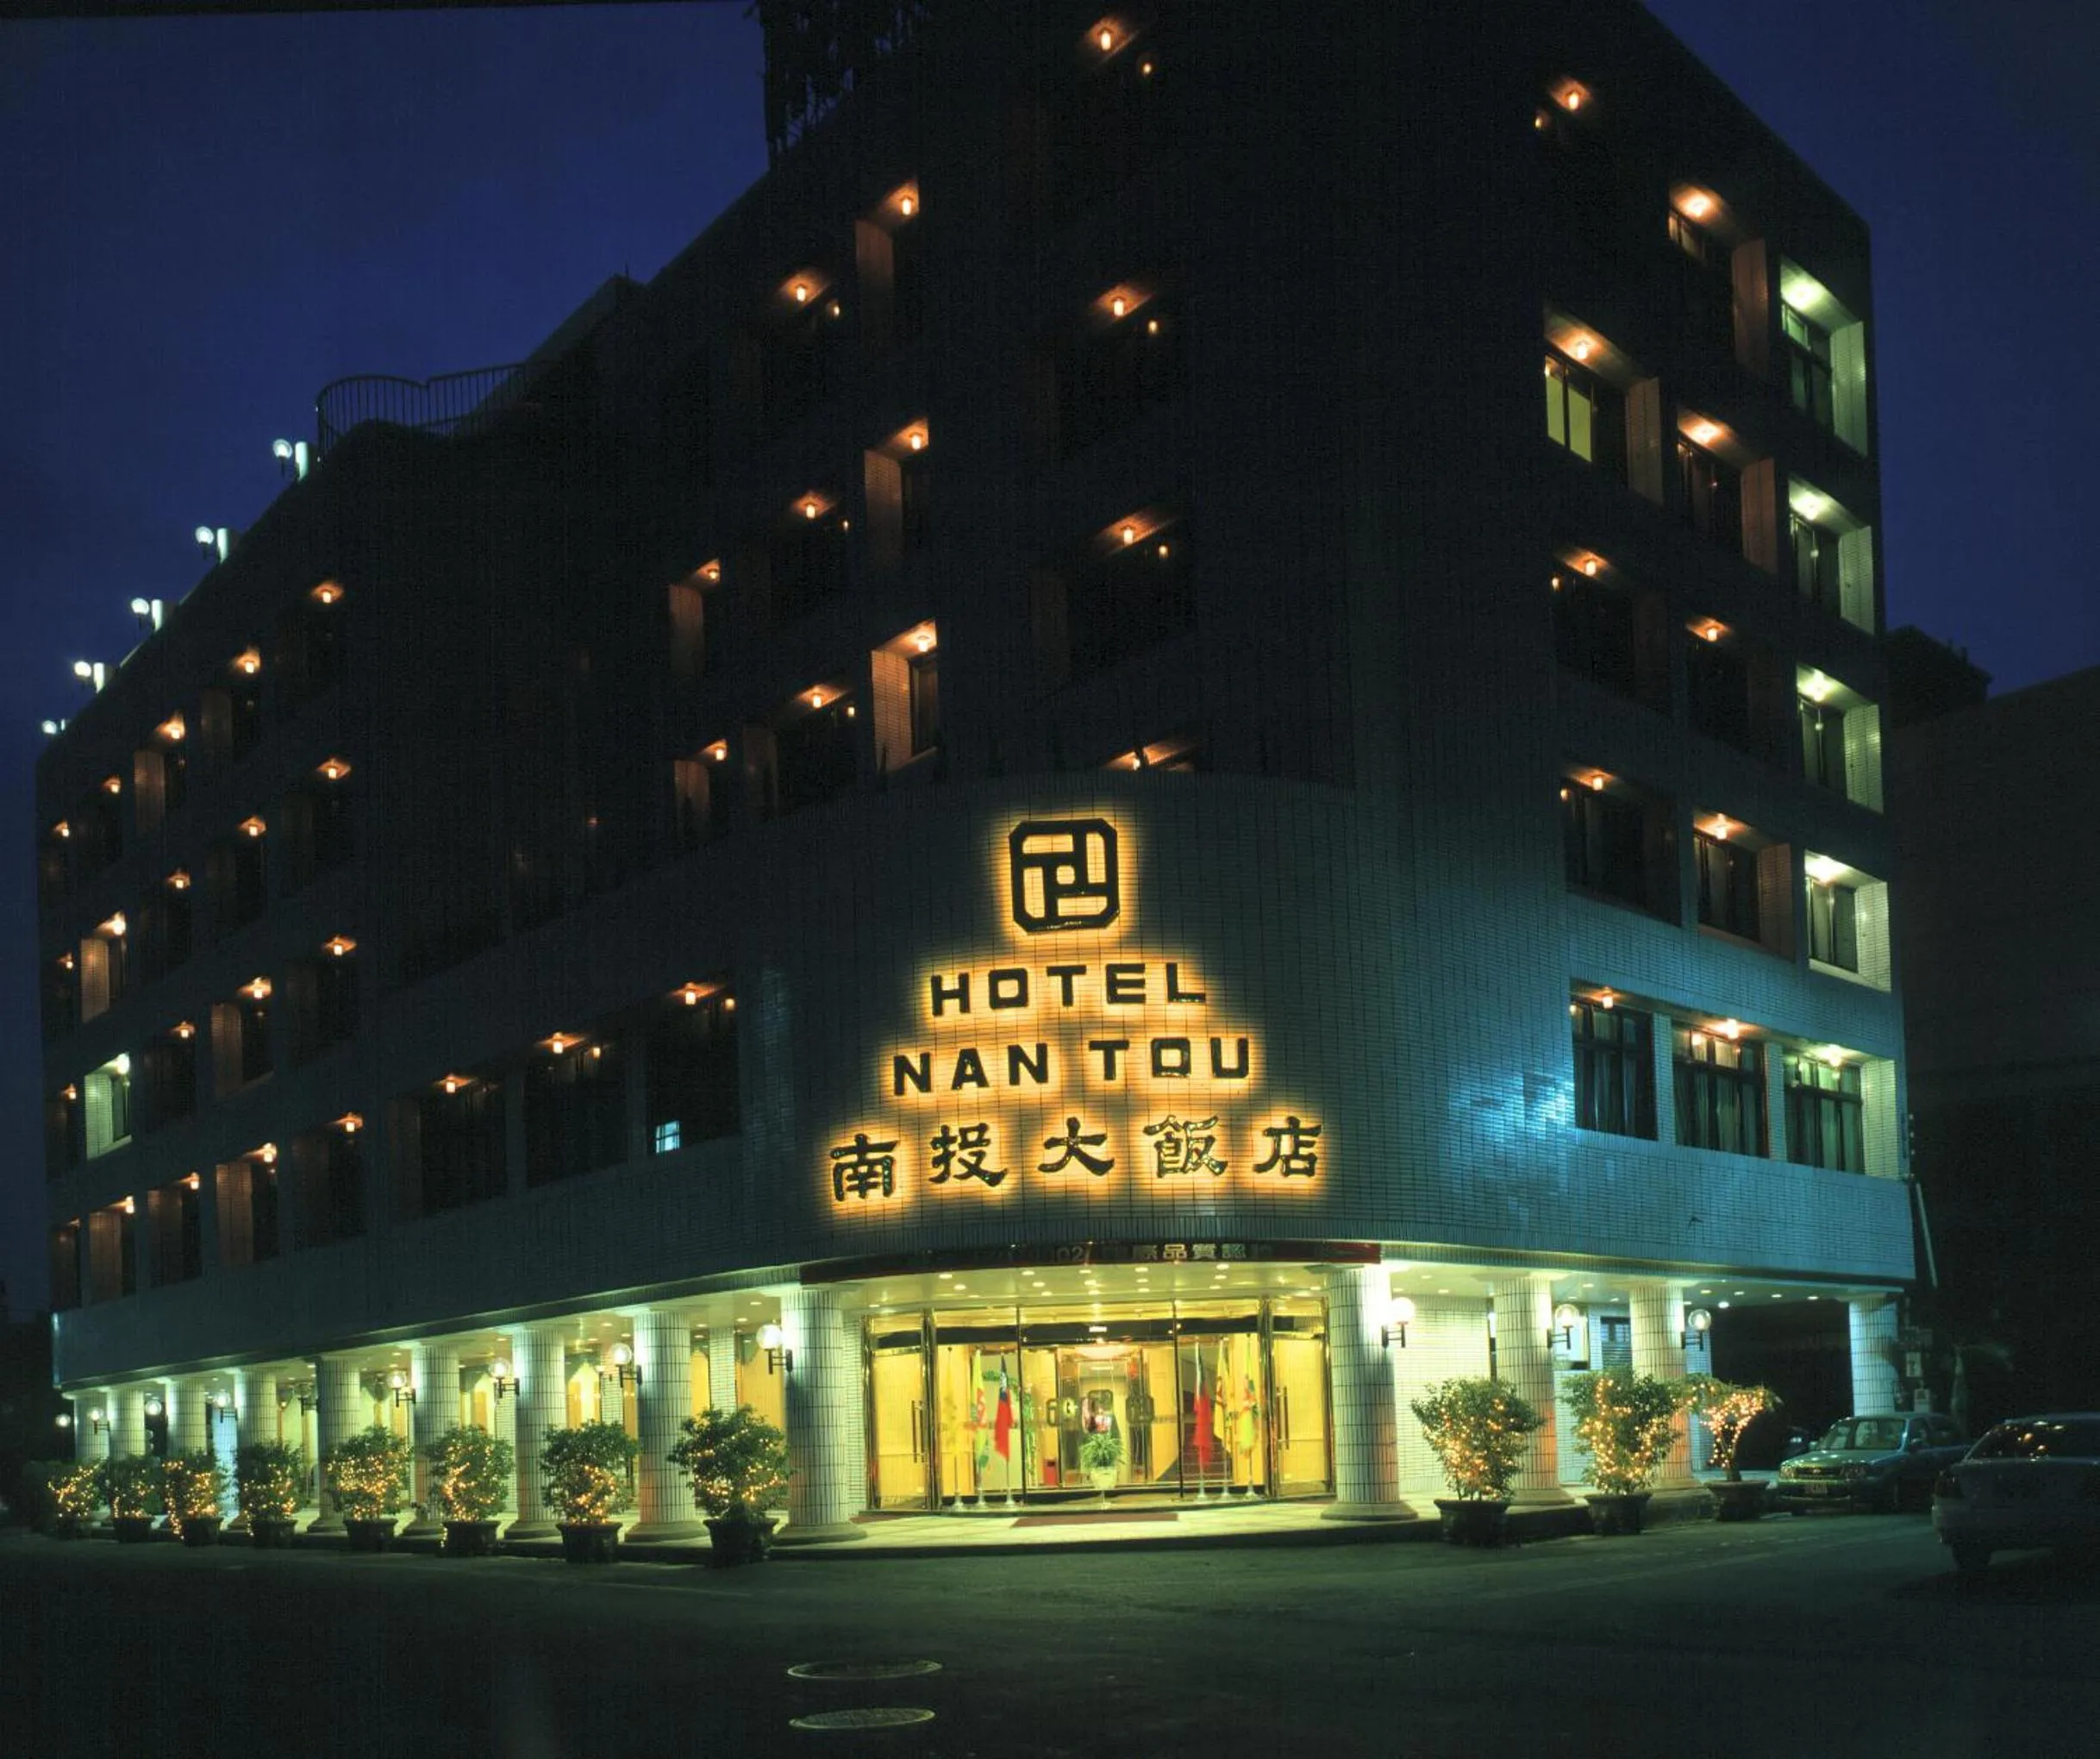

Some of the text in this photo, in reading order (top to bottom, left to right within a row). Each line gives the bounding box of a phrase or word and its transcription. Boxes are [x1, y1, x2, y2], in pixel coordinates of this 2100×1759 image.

[930, 961, 1206, 1016] HOTEL
[894, 1037, 1250, 1096] NAN TOU
[830, 1115, 1323, 1202] 南投大飯店
